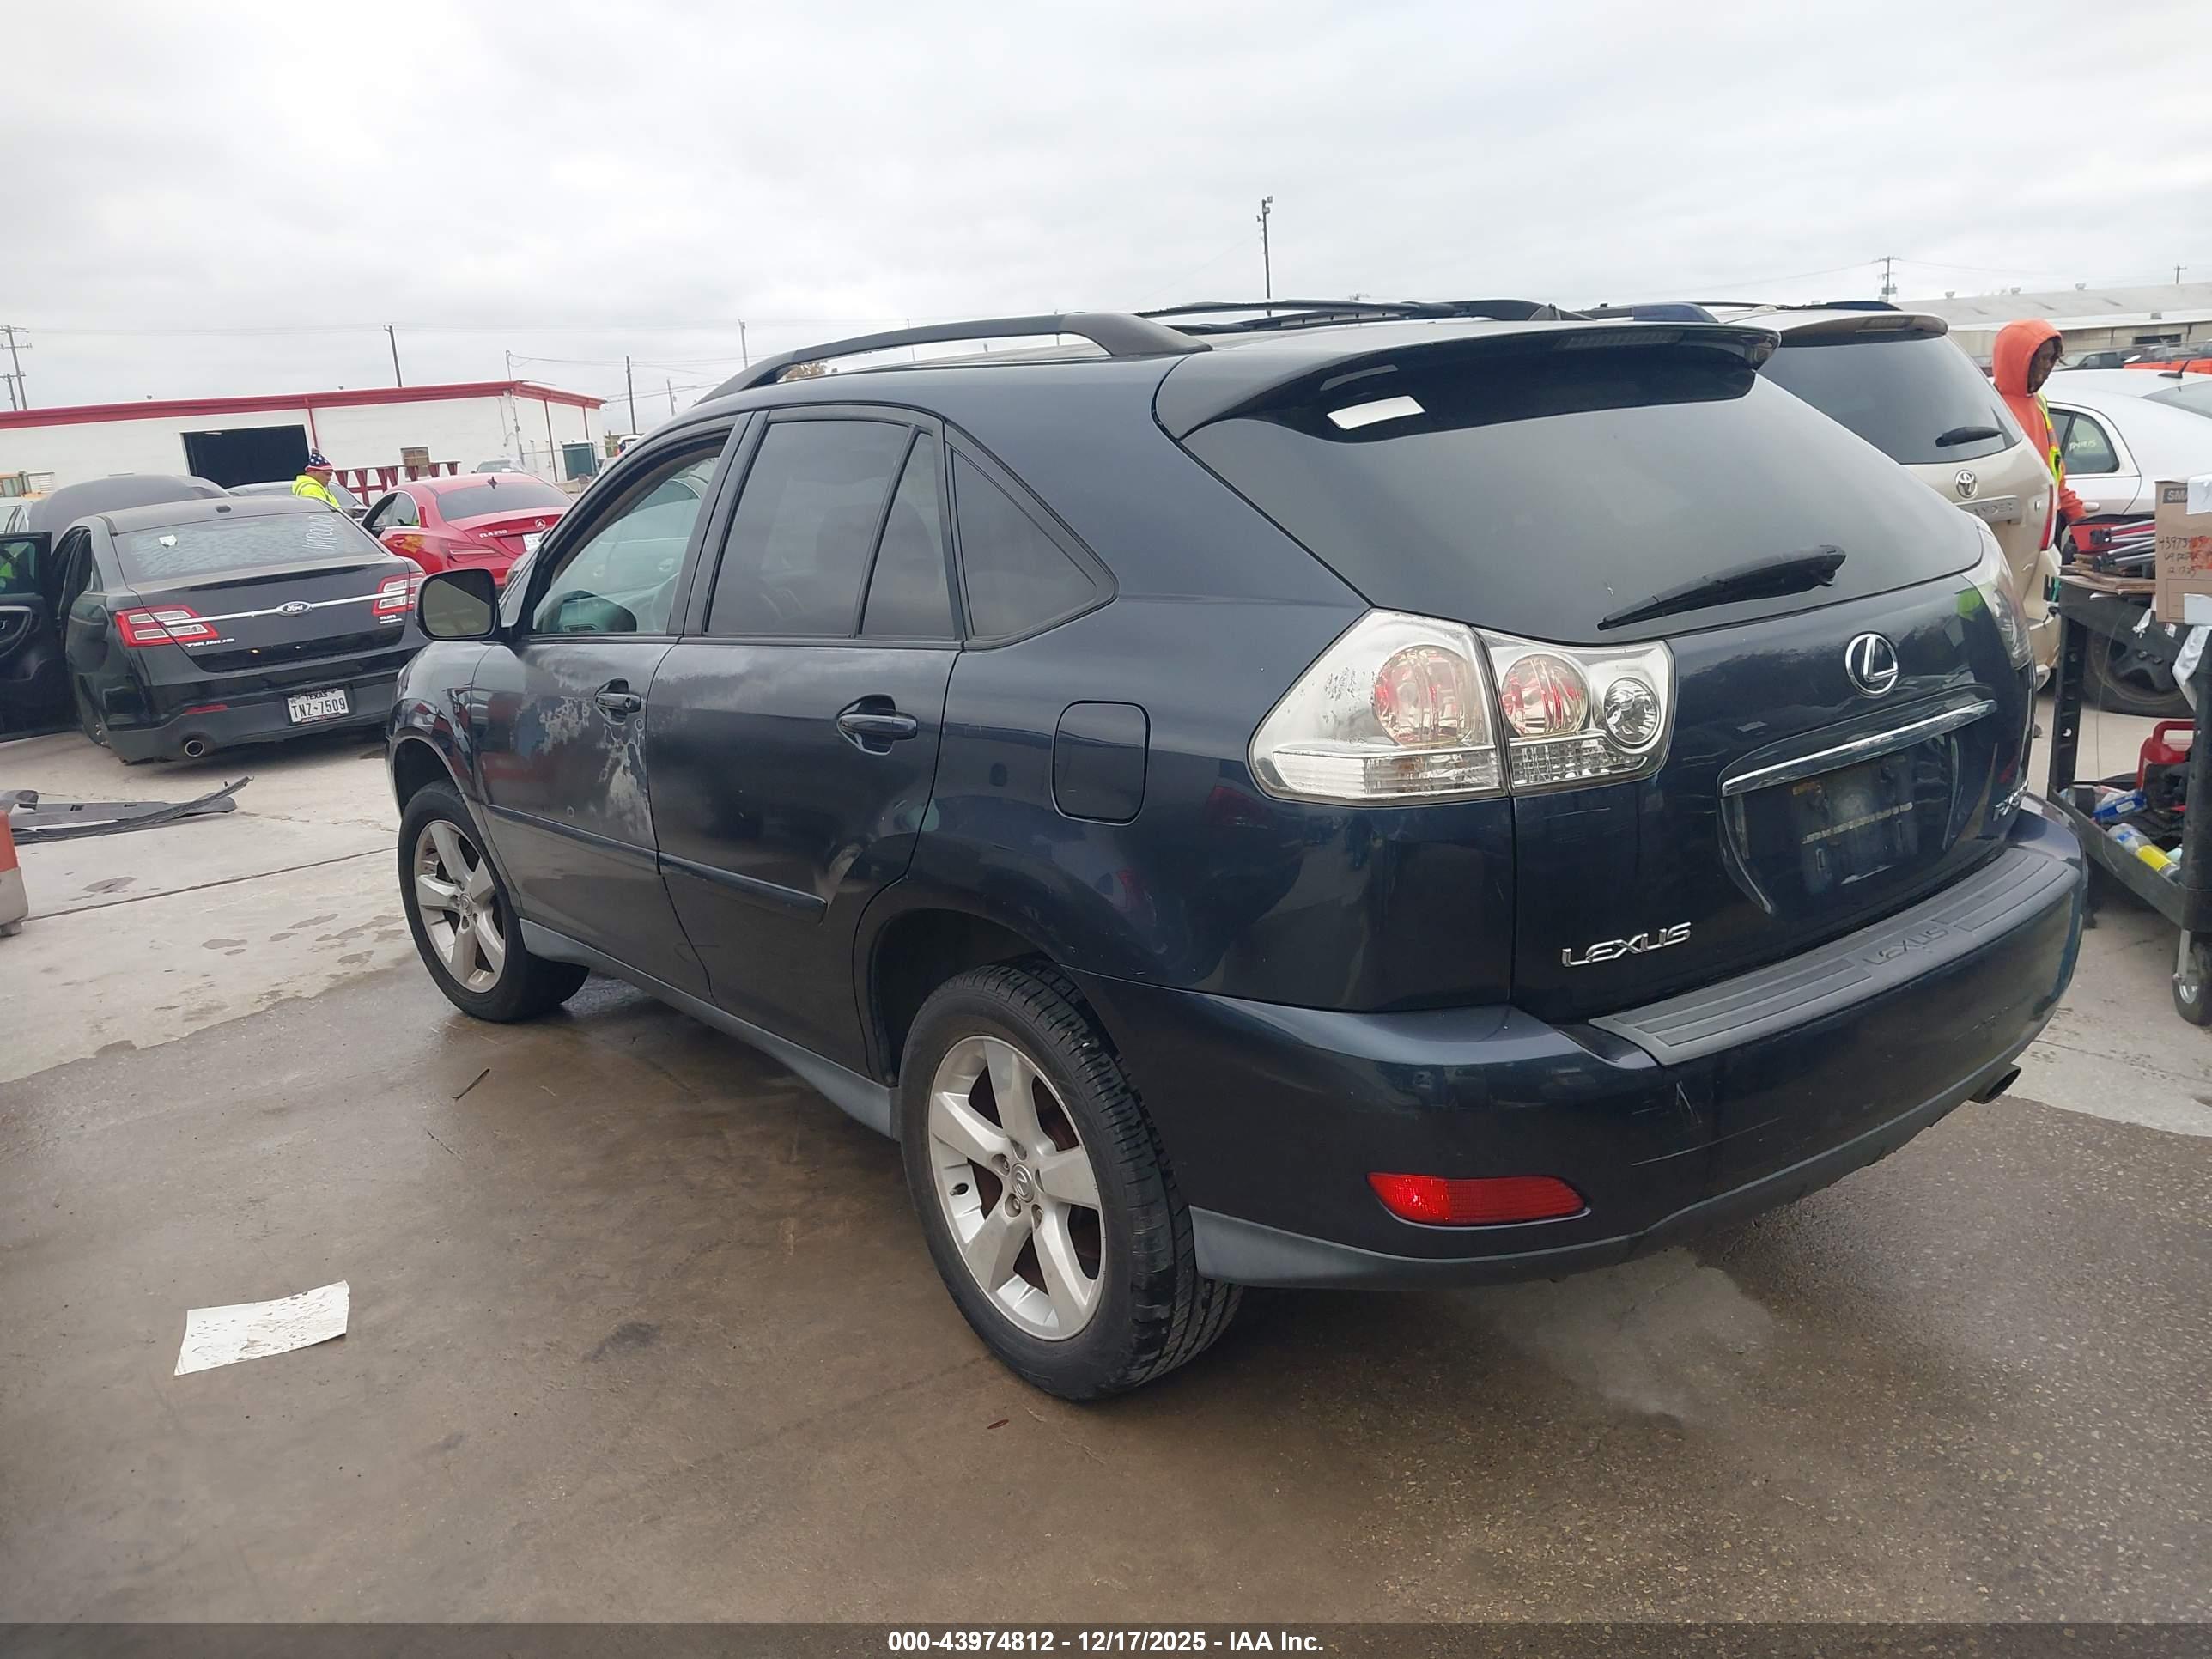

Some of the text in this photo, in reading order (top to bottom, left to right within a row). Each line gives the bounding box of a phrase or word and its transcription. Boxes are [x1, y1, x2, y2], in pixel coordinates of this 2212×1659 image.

[305, 691, 328, 701] TEXAS
[1561, 921, 1692, 967] LEXUS
[1861, 927, 1949, 965] LEXUS
